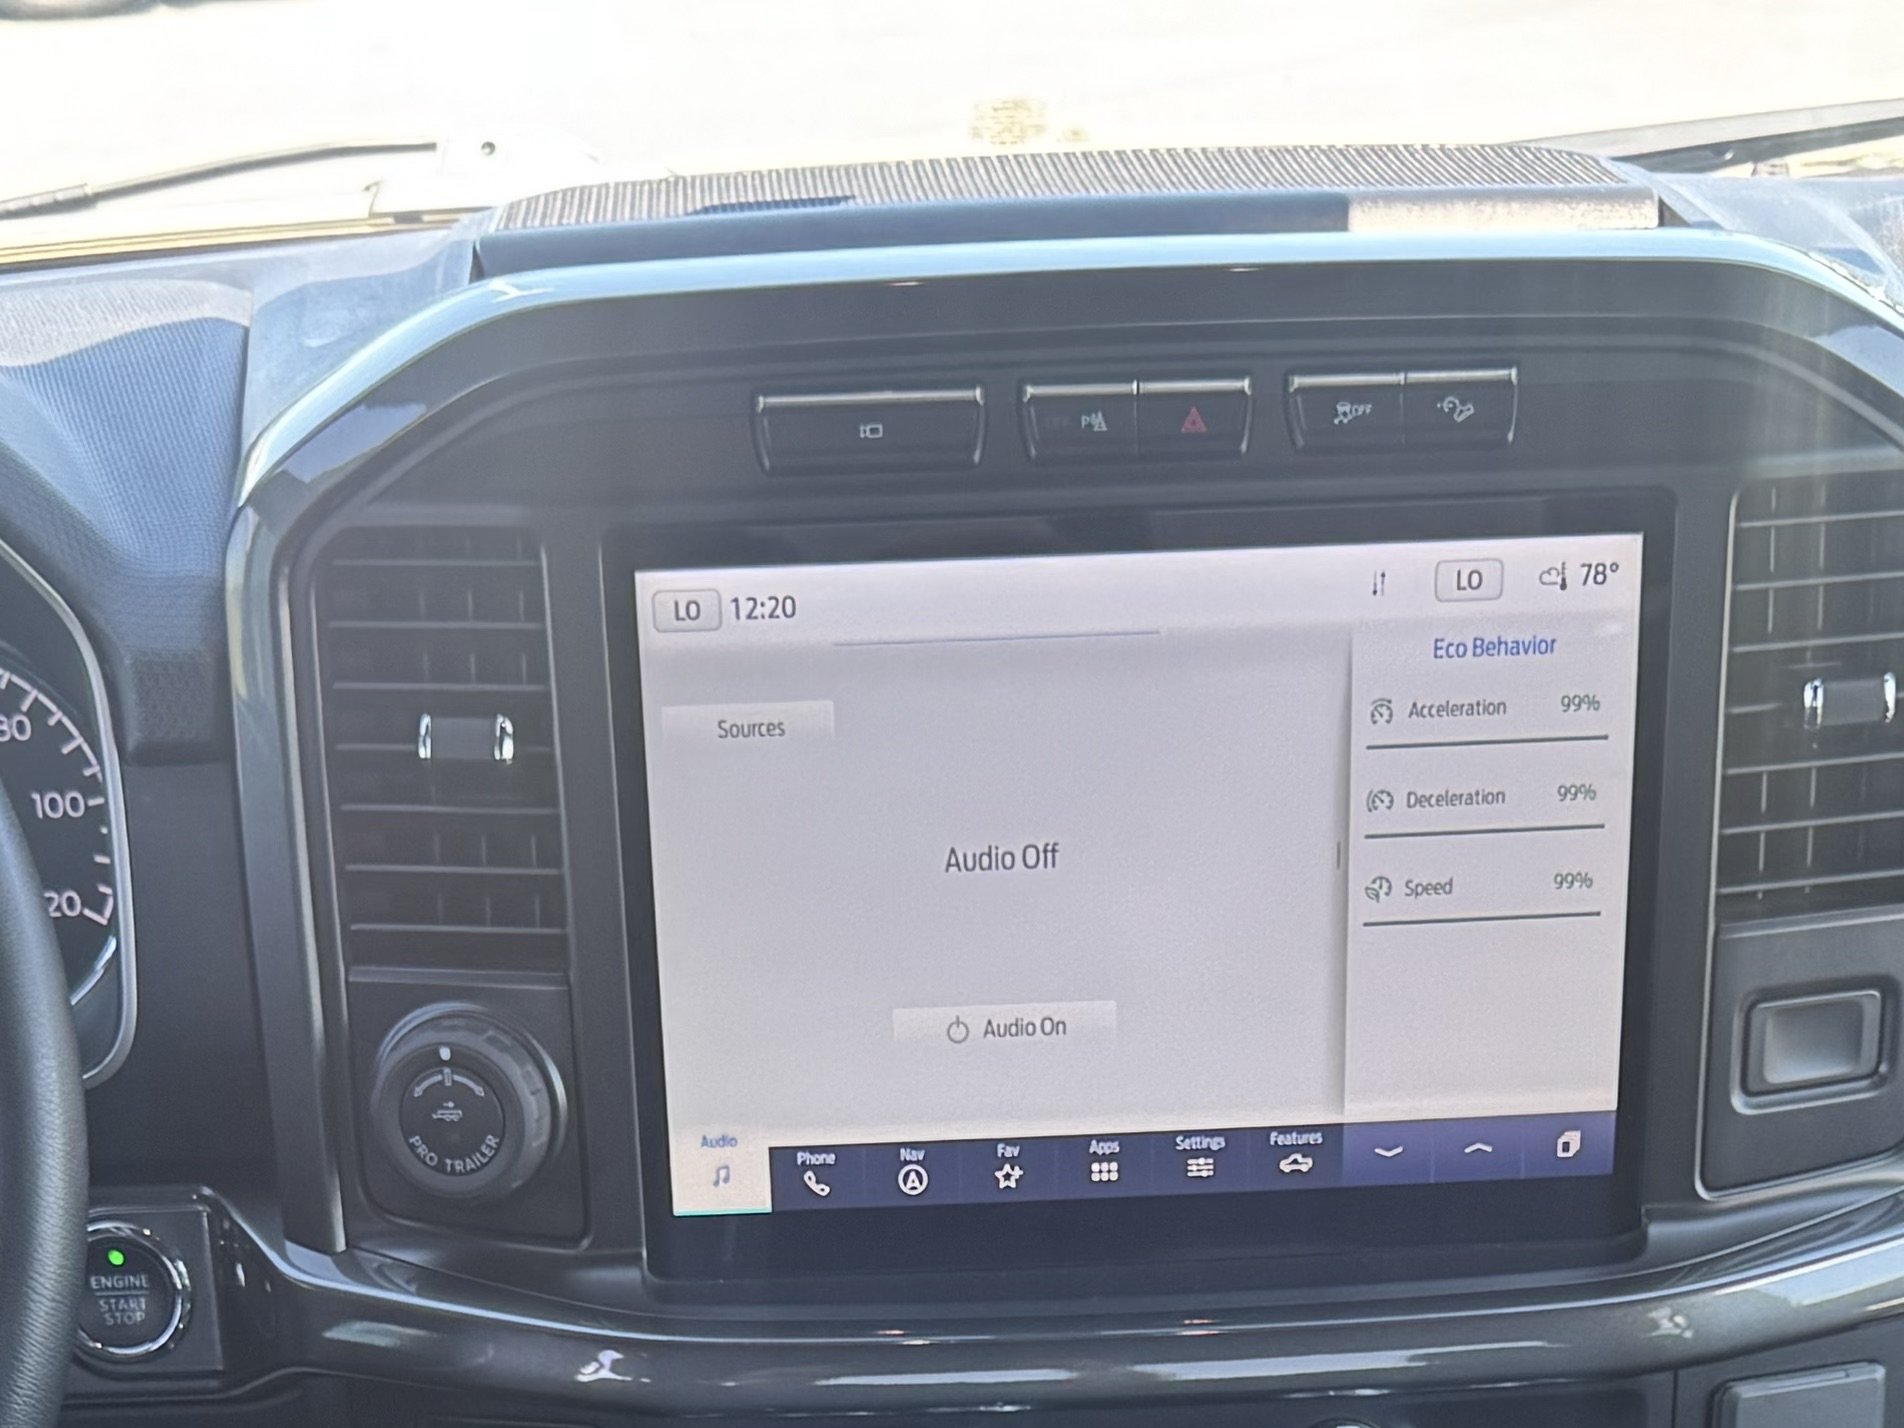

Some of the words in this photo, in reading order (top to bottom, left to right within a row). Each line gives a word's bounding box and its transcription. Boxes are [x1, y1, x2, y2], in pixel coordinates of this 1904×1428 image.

[1456, 569, 1483, 592] LO
[1579, 560, 1619, 588] 78°
[674, 599, 701, 623] LO
[731, 594, 796, 622] 12:20
[1433, 638, 1467, 660] Eco
[1472, 635, 1556, 658] Behavior
[1408, 699, 1507, 721] Acceleration
[1560, 693, 1600, 713] 99%
[716, 717, 785, 741] Sources
[32, 791, 85, 819] 100
[1406, 787, 1505, 810] Deceleration
[1557, 783, 1596, 802] 99%
[944, 845, 1015, 874] Audio
[1021, 842, 1059, 871] Off
[1404, 877, 1453, 900] Speed
[1553, 871, 1593, 891] 99%
[45, 890, 81, 918] 20
[983, 1016, 1036, 1040] Audio
[1039, 1016, 1067, 1038] On
[700, 1134, 738, 1151] Audio
[996, 1143, 1019, 1159] Fav
[1089, 1138, 1119, 1157] Apps
[1175, 1134, 1225, 1153] Settings
[1270, 1130, 1323, 1148] Features
[409, 1135, 438, 1167] PRO
[445, 1135, 500, 1173] TRAILER
[796, 1150, 836, 1167] Phone
[900, 1146, 924, 1163] Nav
[90, 1274, 150, 1289] ENGINE
[98, 1298, 146, 1312] START
[103, 1311, 146, 1326] STOP
